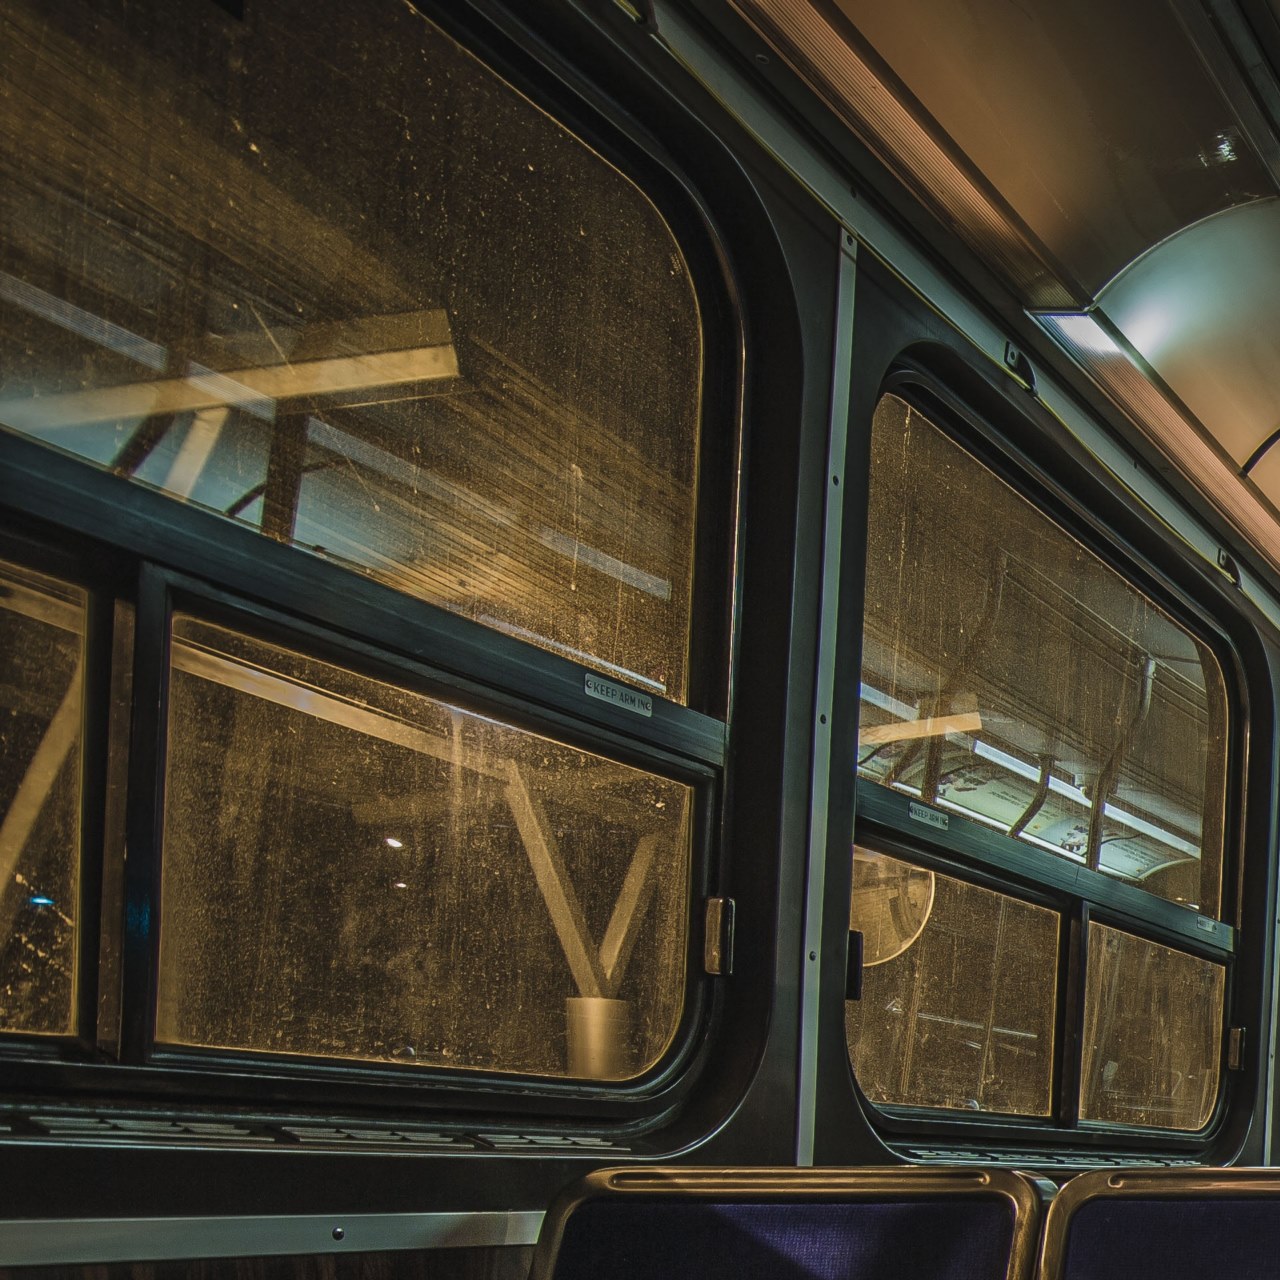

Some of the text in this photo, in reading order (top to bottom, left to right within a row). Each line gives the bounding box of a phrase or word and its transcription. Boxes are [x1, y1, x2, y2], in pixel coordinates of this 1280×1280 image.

[593, 682, 646, 711] KEEP ARM IN
